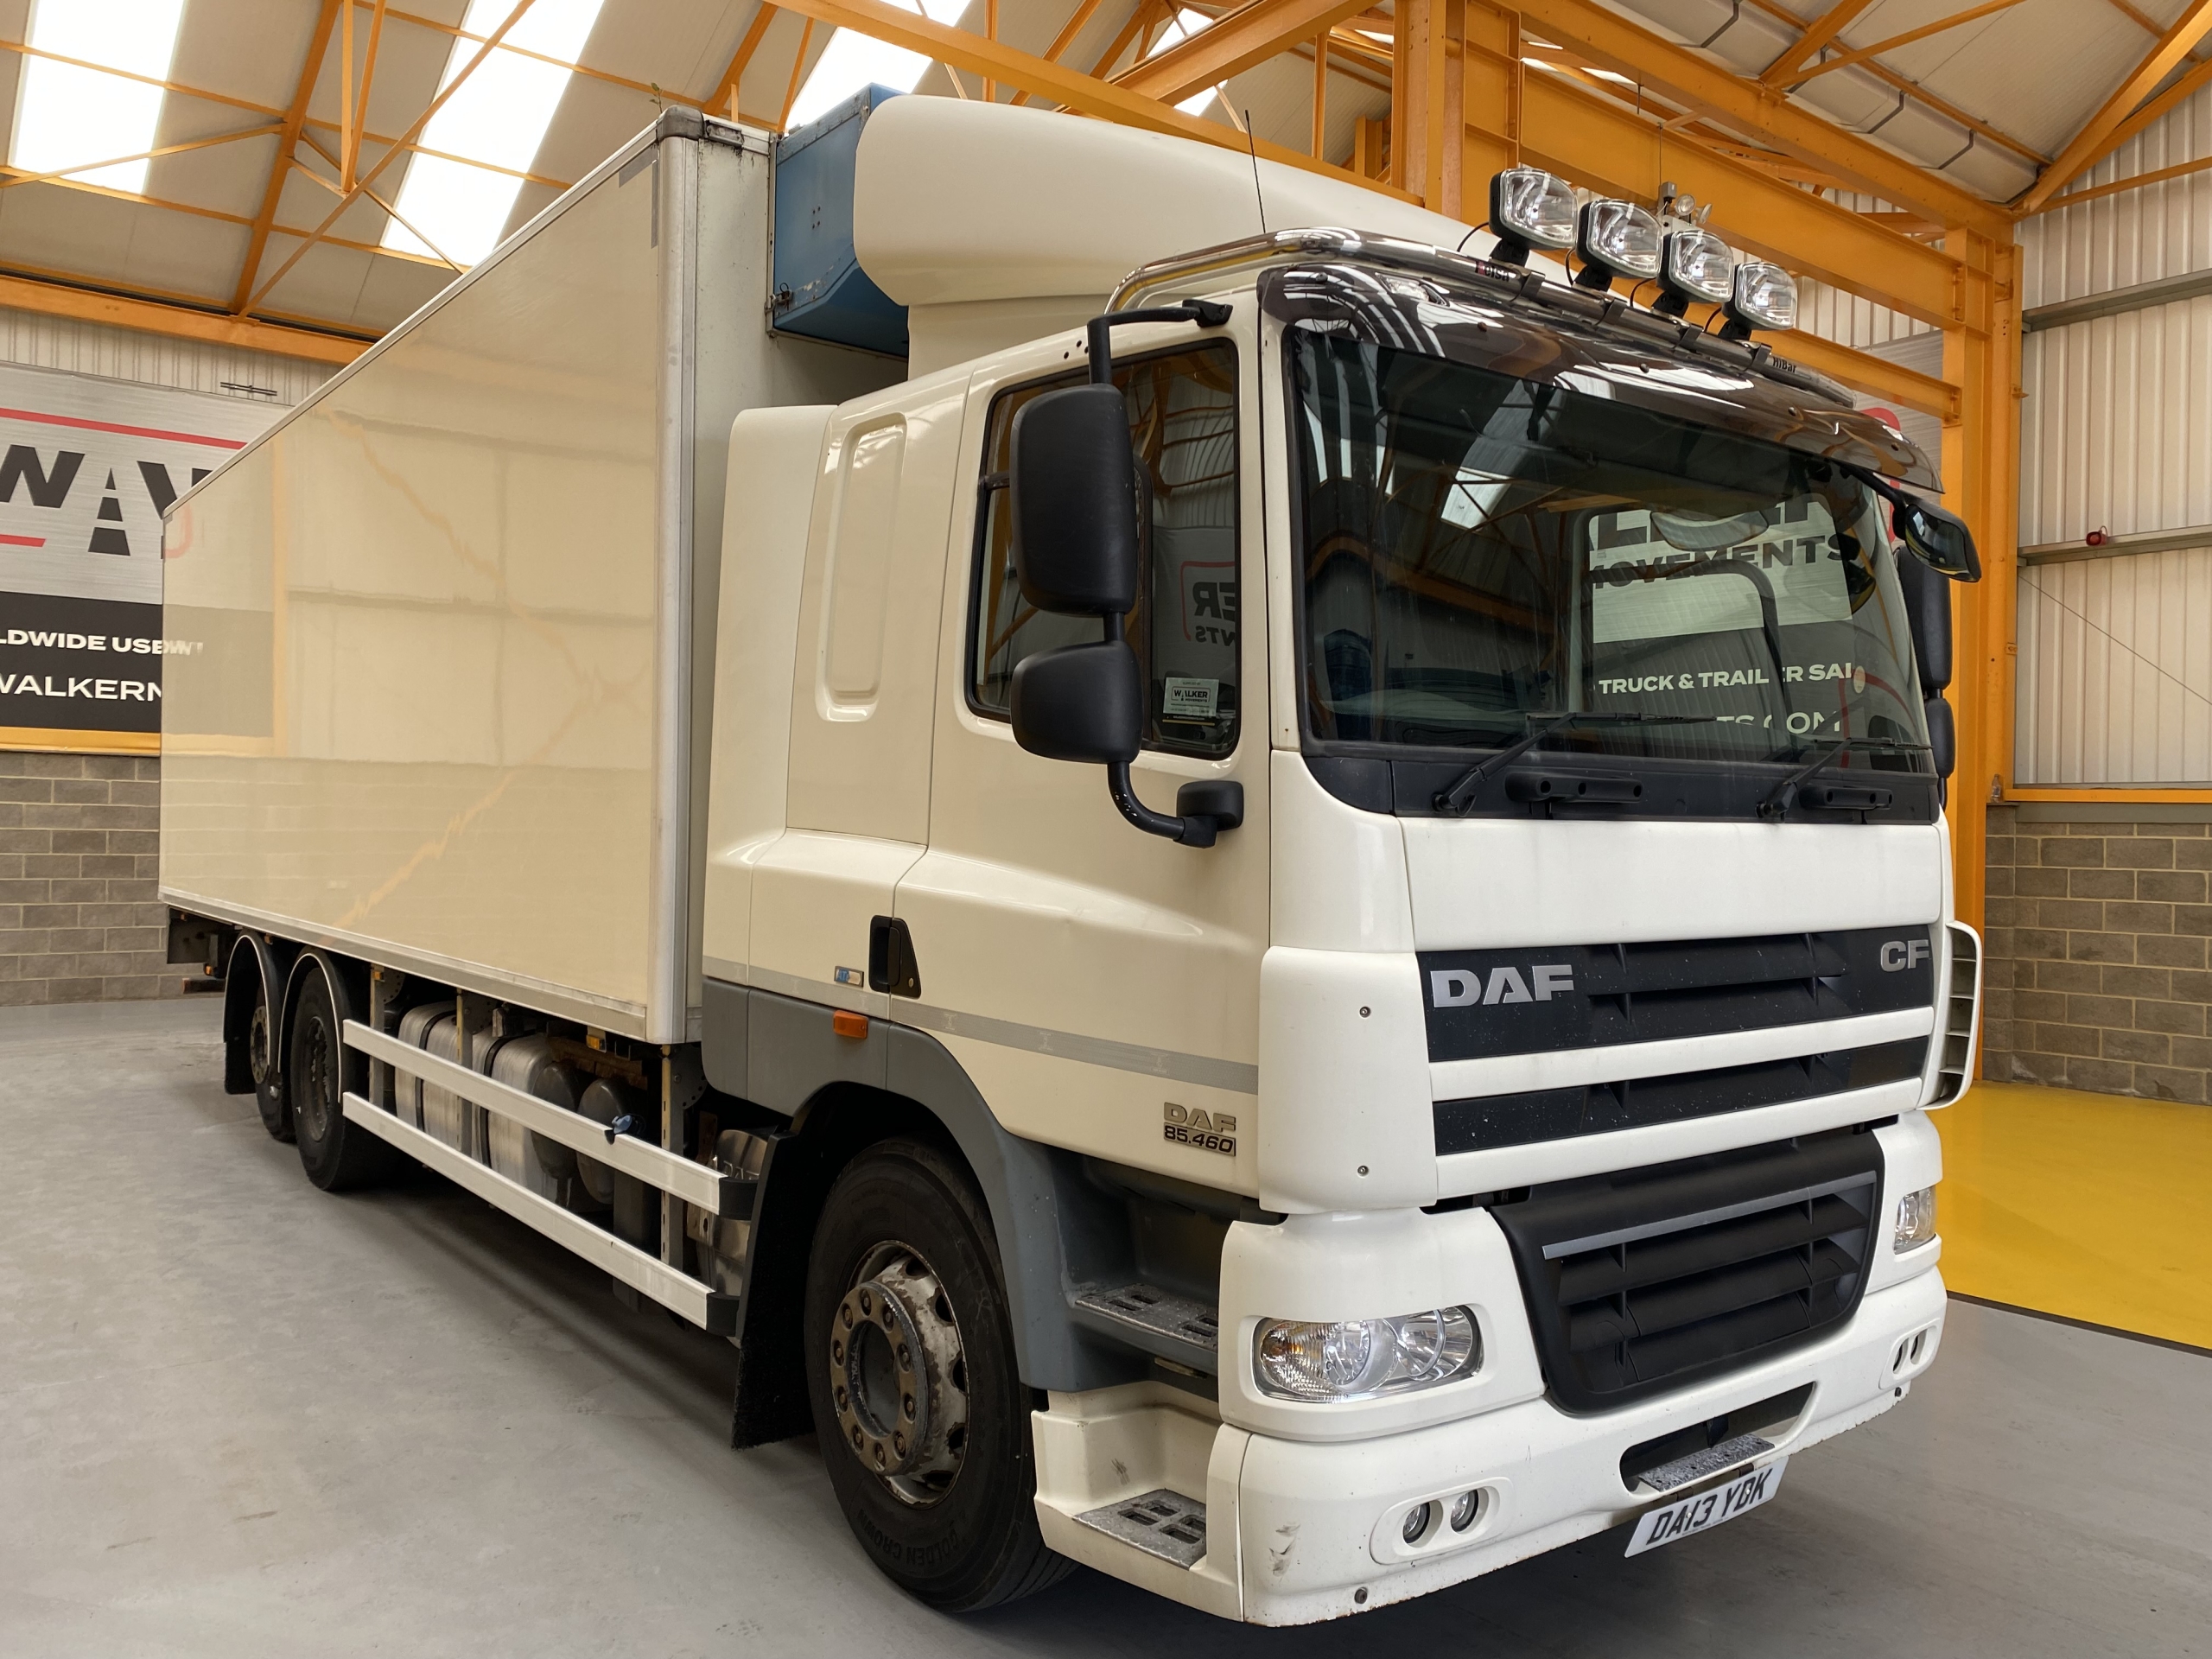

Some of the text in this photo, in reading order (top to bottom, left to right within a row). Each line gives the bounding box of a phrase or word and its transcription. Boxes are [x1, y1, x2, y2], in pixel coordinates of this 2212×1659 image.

[0, 629, 106, 651] DWIDE
[1173, 690, 1209, 699] WALKER
[1599, 675, 1675, 694] TRUCK
[1678, 673, 1695, 690] &
[1698, 665, 1803, 688] TRAILR
[1880, 939, 1929, 973] CF
[1430, 963, 1573, 1008] DAF
[1164, 1102, 1236, 1134] DAF
[1164, 1125, 1234, 1154] 85.460
[1645, 1493, 1718, 1546] DA13
